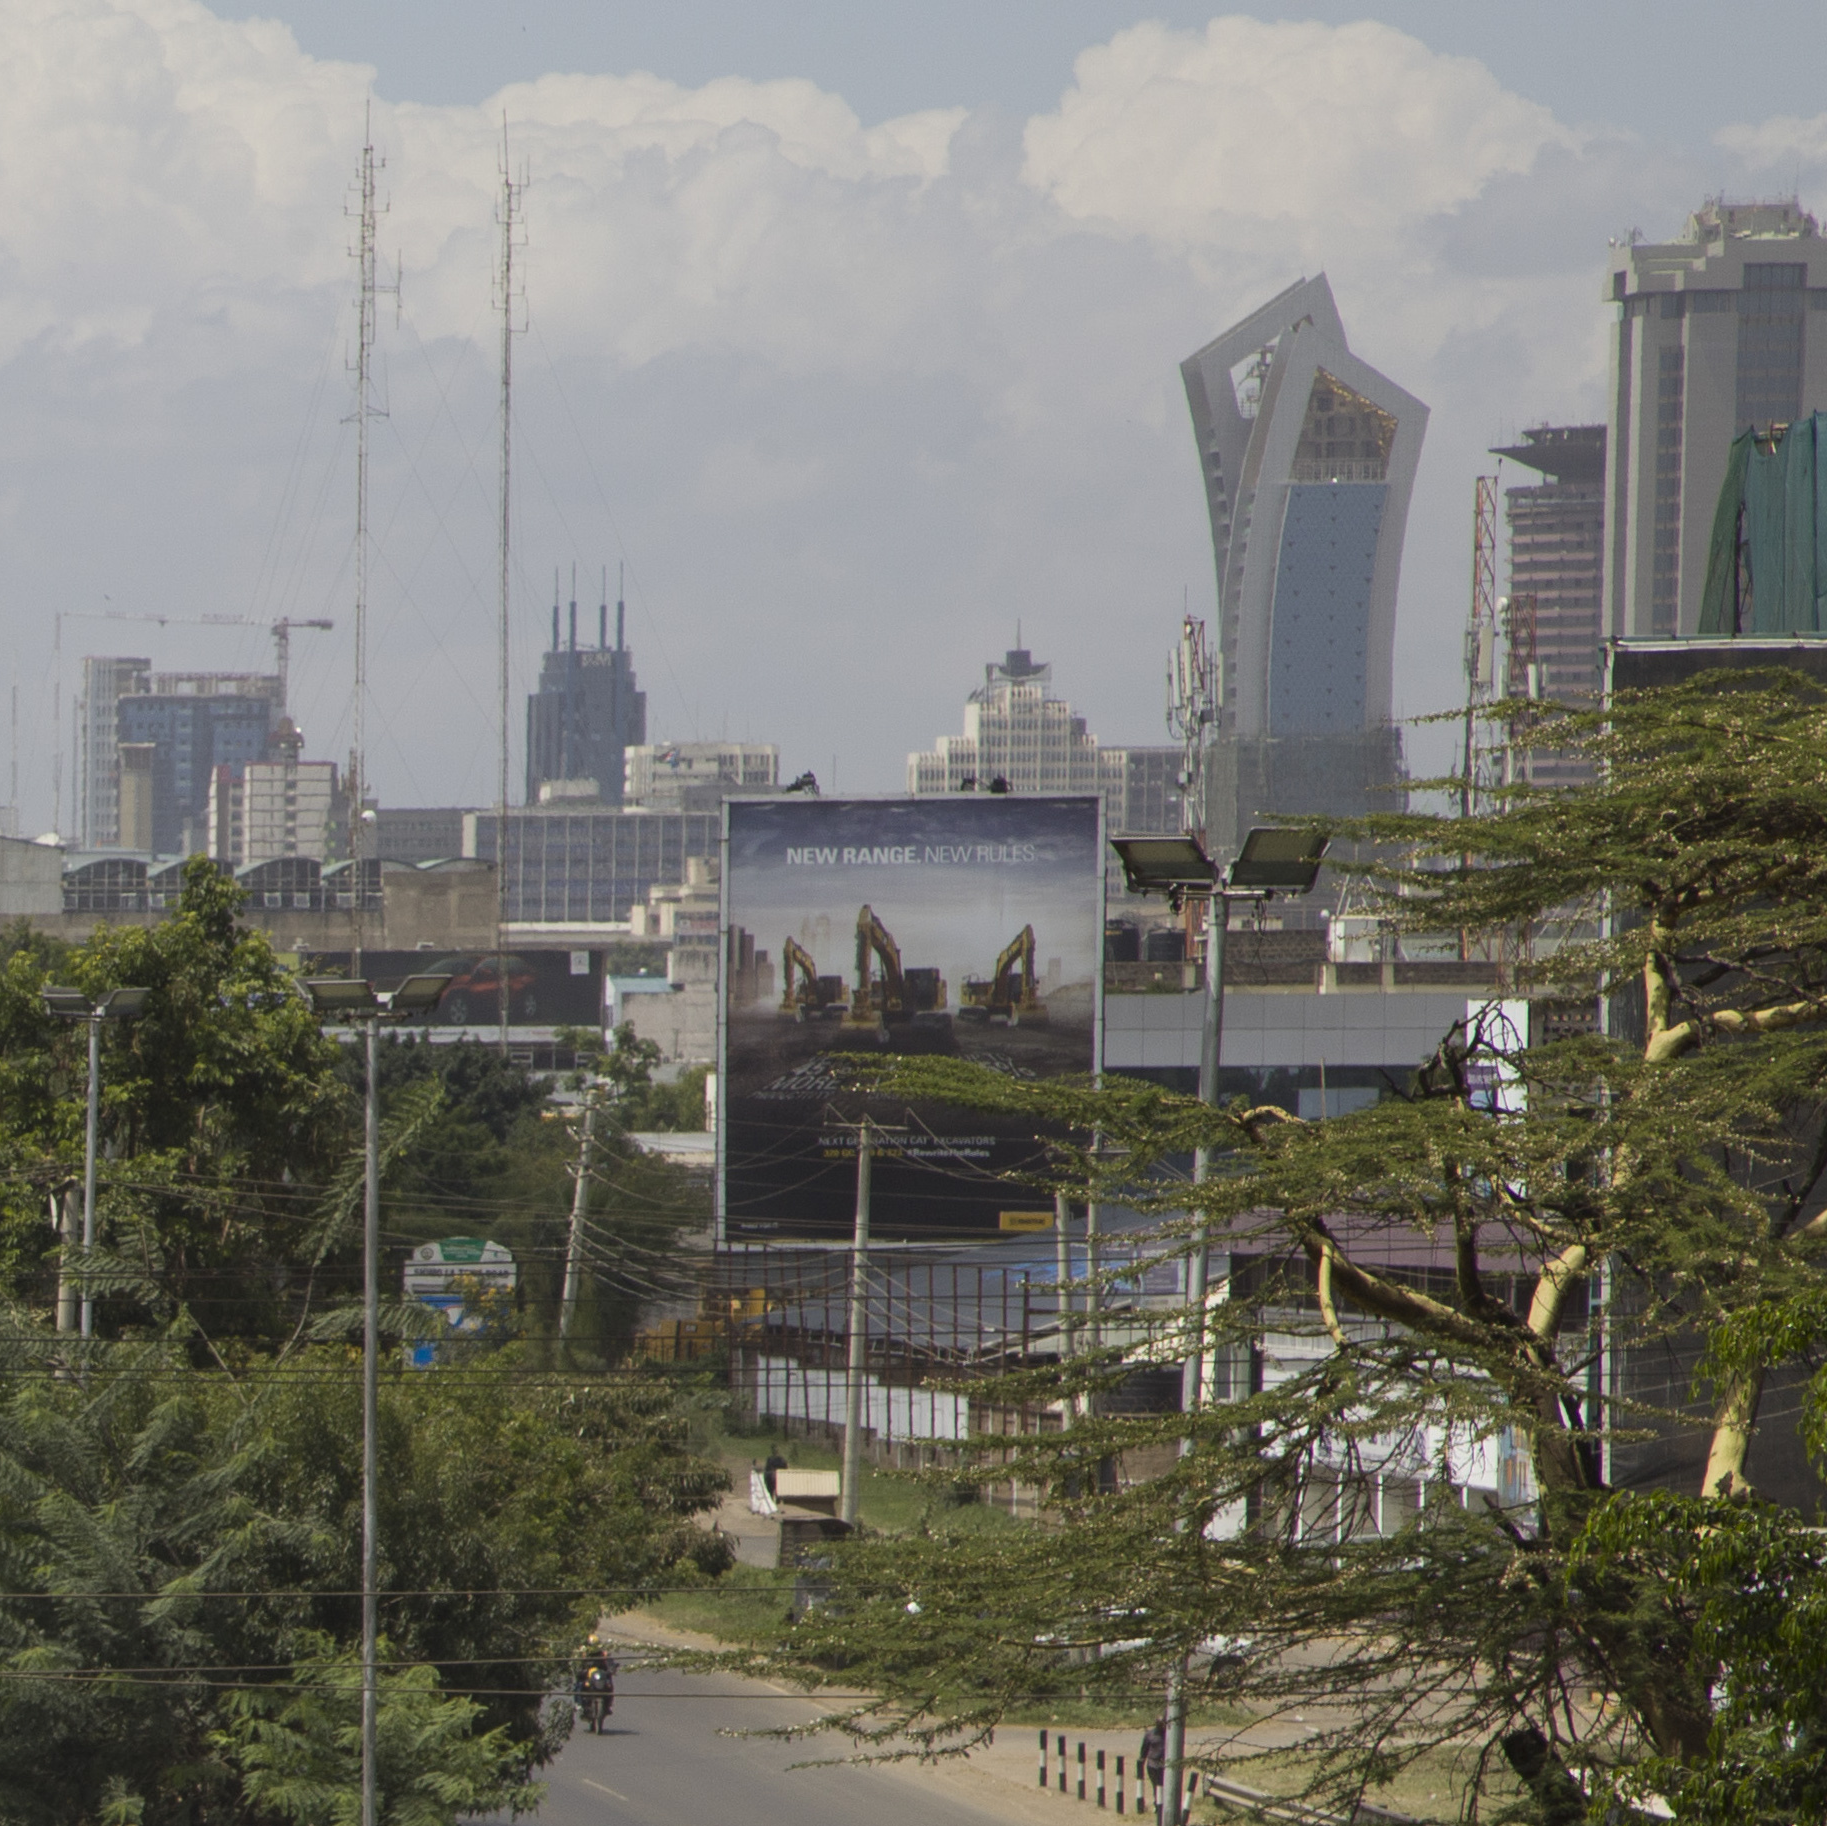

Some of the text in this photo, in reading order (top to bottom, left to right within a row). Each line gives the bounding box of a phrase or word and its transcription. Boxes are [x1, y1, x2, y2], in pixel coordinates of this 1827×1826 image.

[787, 847, 843, 865] NEW
[844, 846, 921, 865] RANGE.
[925, 845, 972, 862] NEW
[818, 1136, 845, 1146] NEXT
